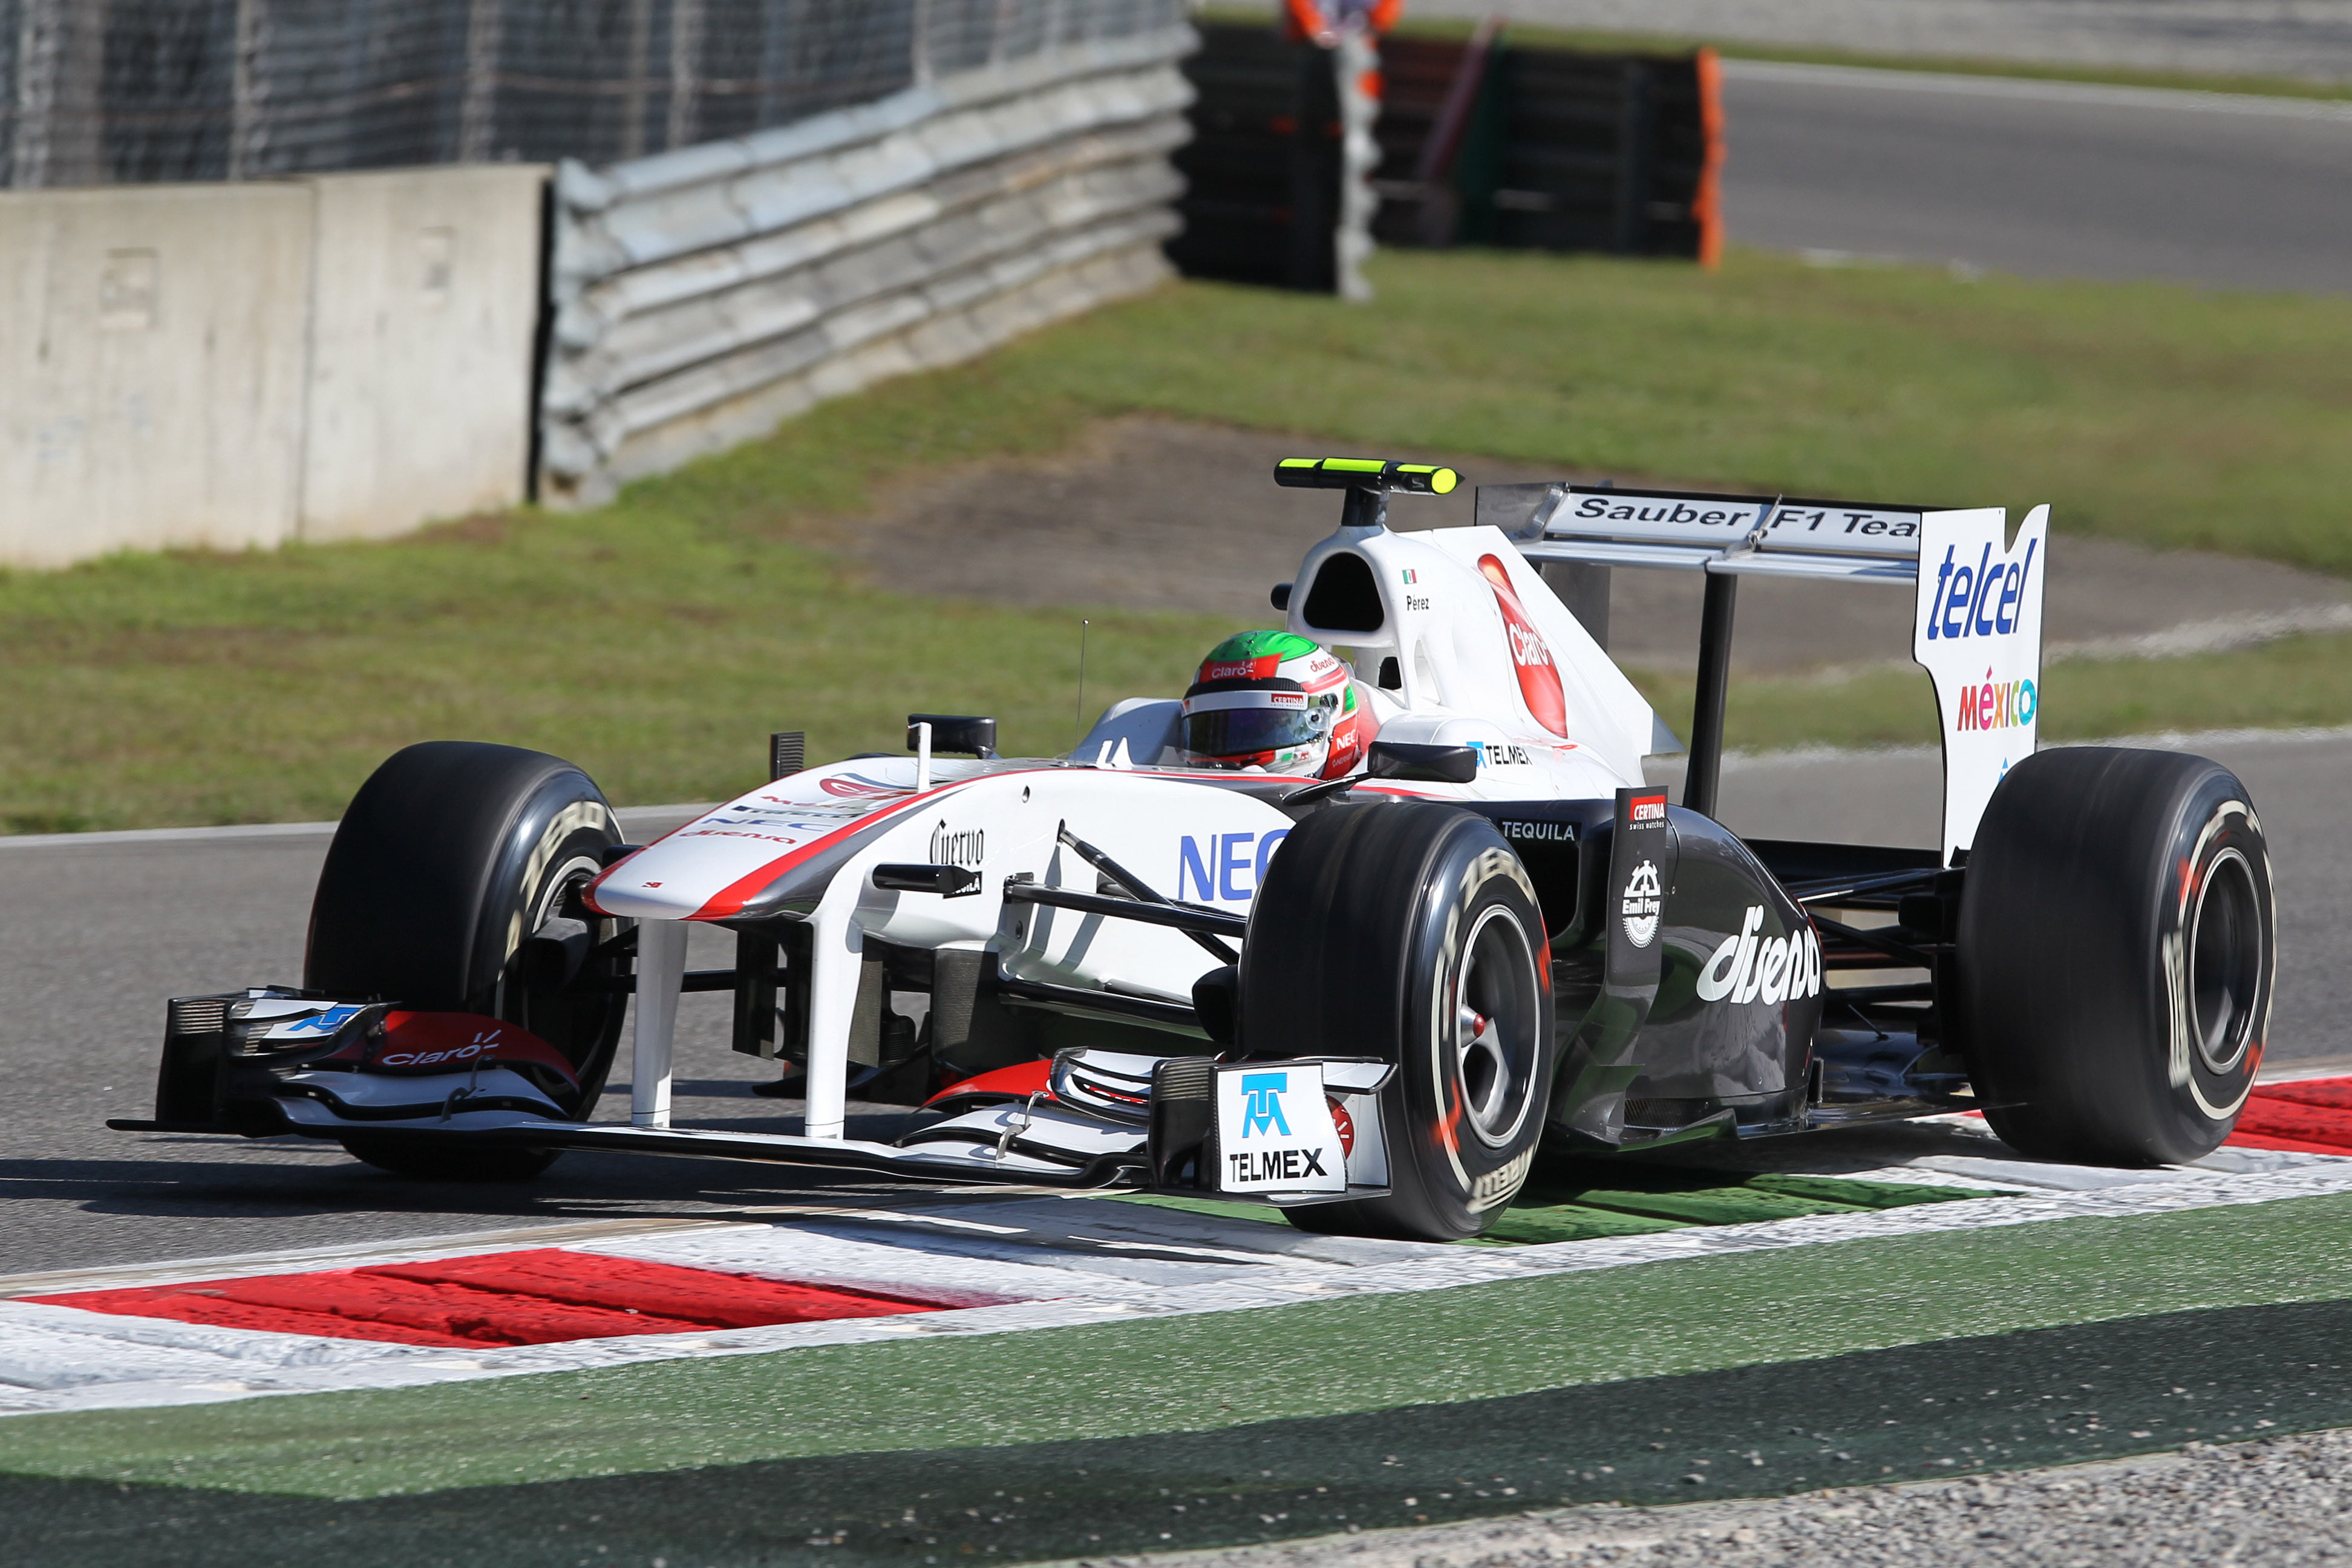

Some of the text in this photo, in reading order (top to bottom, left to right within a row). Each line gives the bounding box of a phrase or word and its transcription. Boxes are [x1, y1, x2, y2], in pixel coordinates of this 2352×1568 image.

[1575, 498, 1920, 538] Sauber F1 Tea
[1927, 538, 2038, 640] telcel
[1406, 595, 1429, 611] Pérez
[1211, 667, 1247, 679] Claro
[1336, 728, 1356, 751] NEC
[1485, 745, 1533, 765] TELMEX
[1634, 803, 1665, 821] CERTINA
[701, 818, 834, 832] NEC
[1501, 822, 1575, 841] TEQUILA
[1629, 821, 1665, 831] swiss watches
[1622, 898, 1661, 916] Emil Frey
[382, 1044, 482, 1065] Claro
[1229, 1148, 1328, 1183] TELMEX
